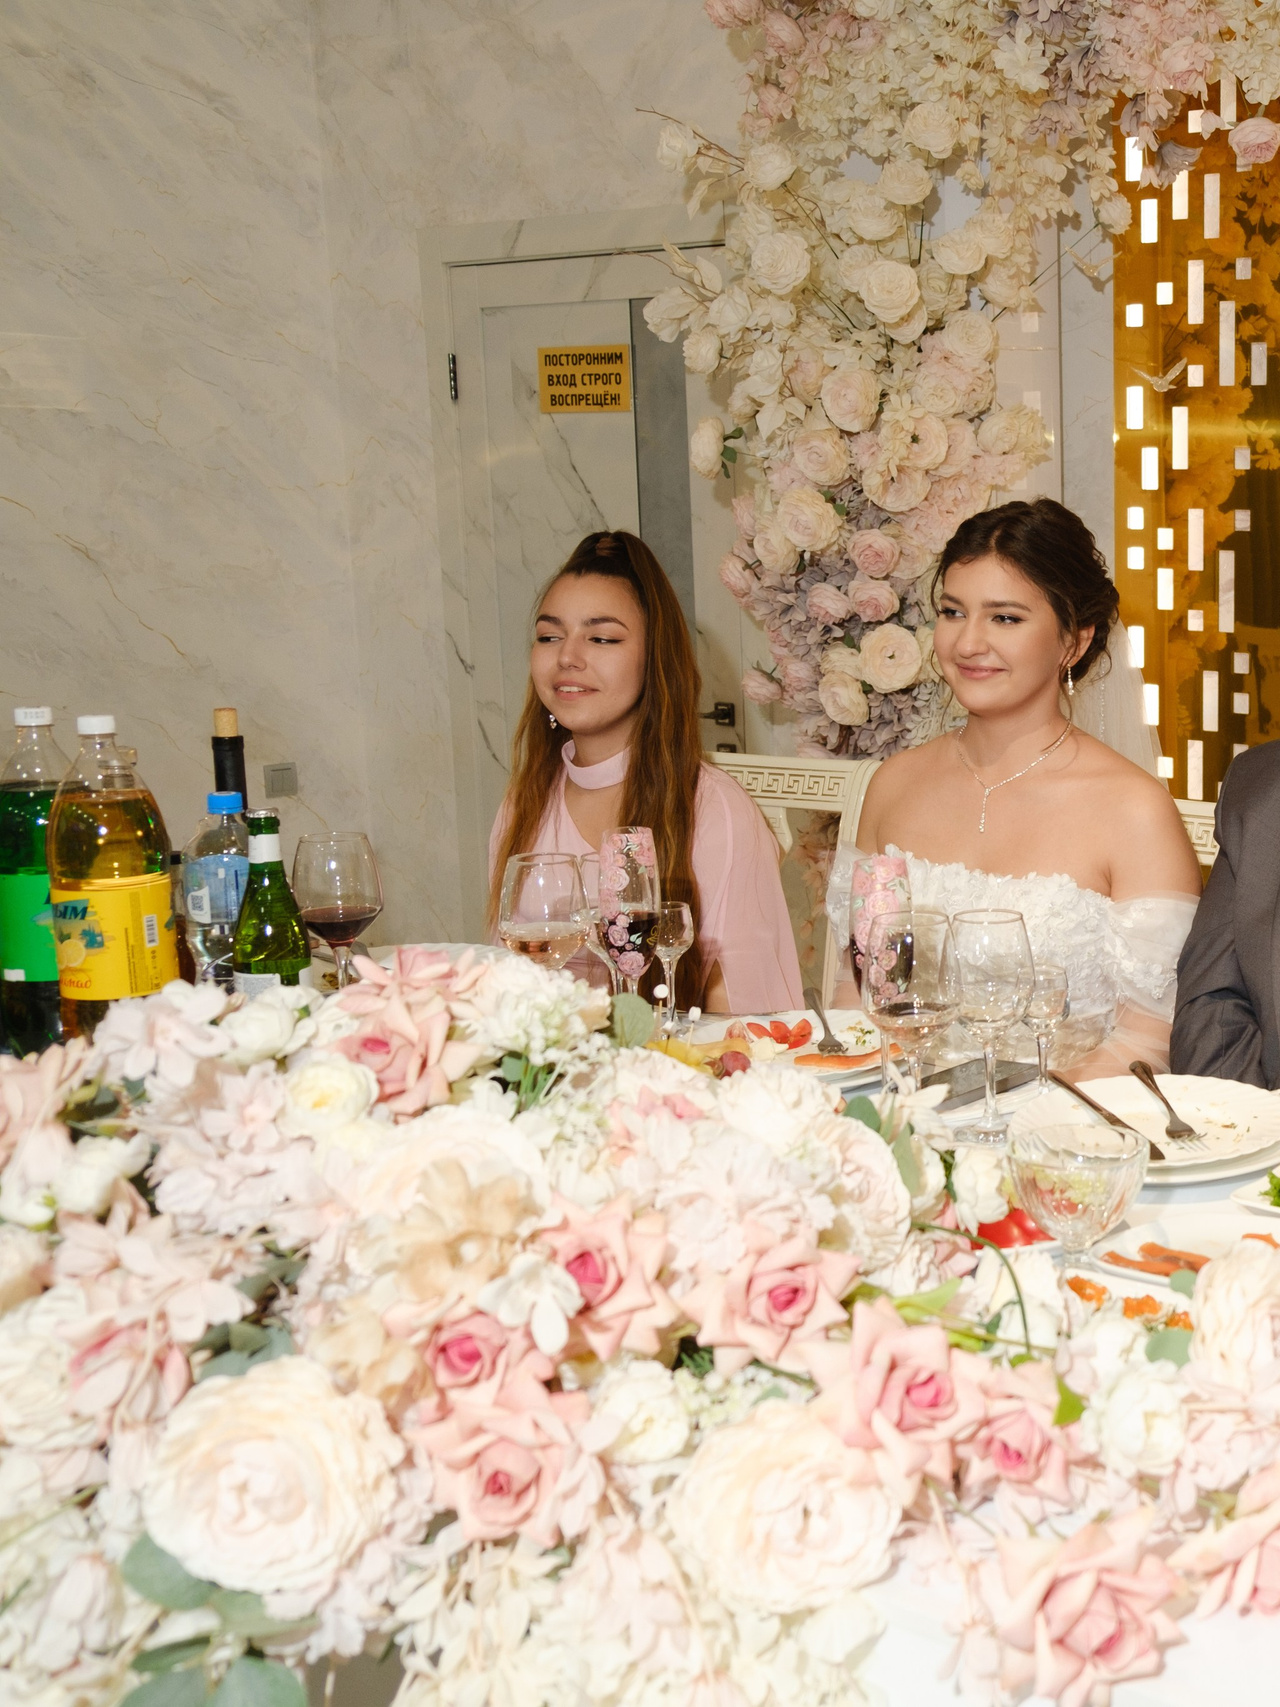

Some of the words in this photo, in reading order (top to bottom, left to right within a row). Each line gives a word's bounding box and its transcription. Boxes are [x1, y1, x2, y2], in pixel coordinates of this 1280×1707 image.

[544, 352, 623, 367] ПОСТОРОННИМ
[547, 374, 577, 388] ВХОД
[581, 373, 622, 386] СТРОГО
[550, 390, 621, 408] ВОСПРЕЩЁН!
